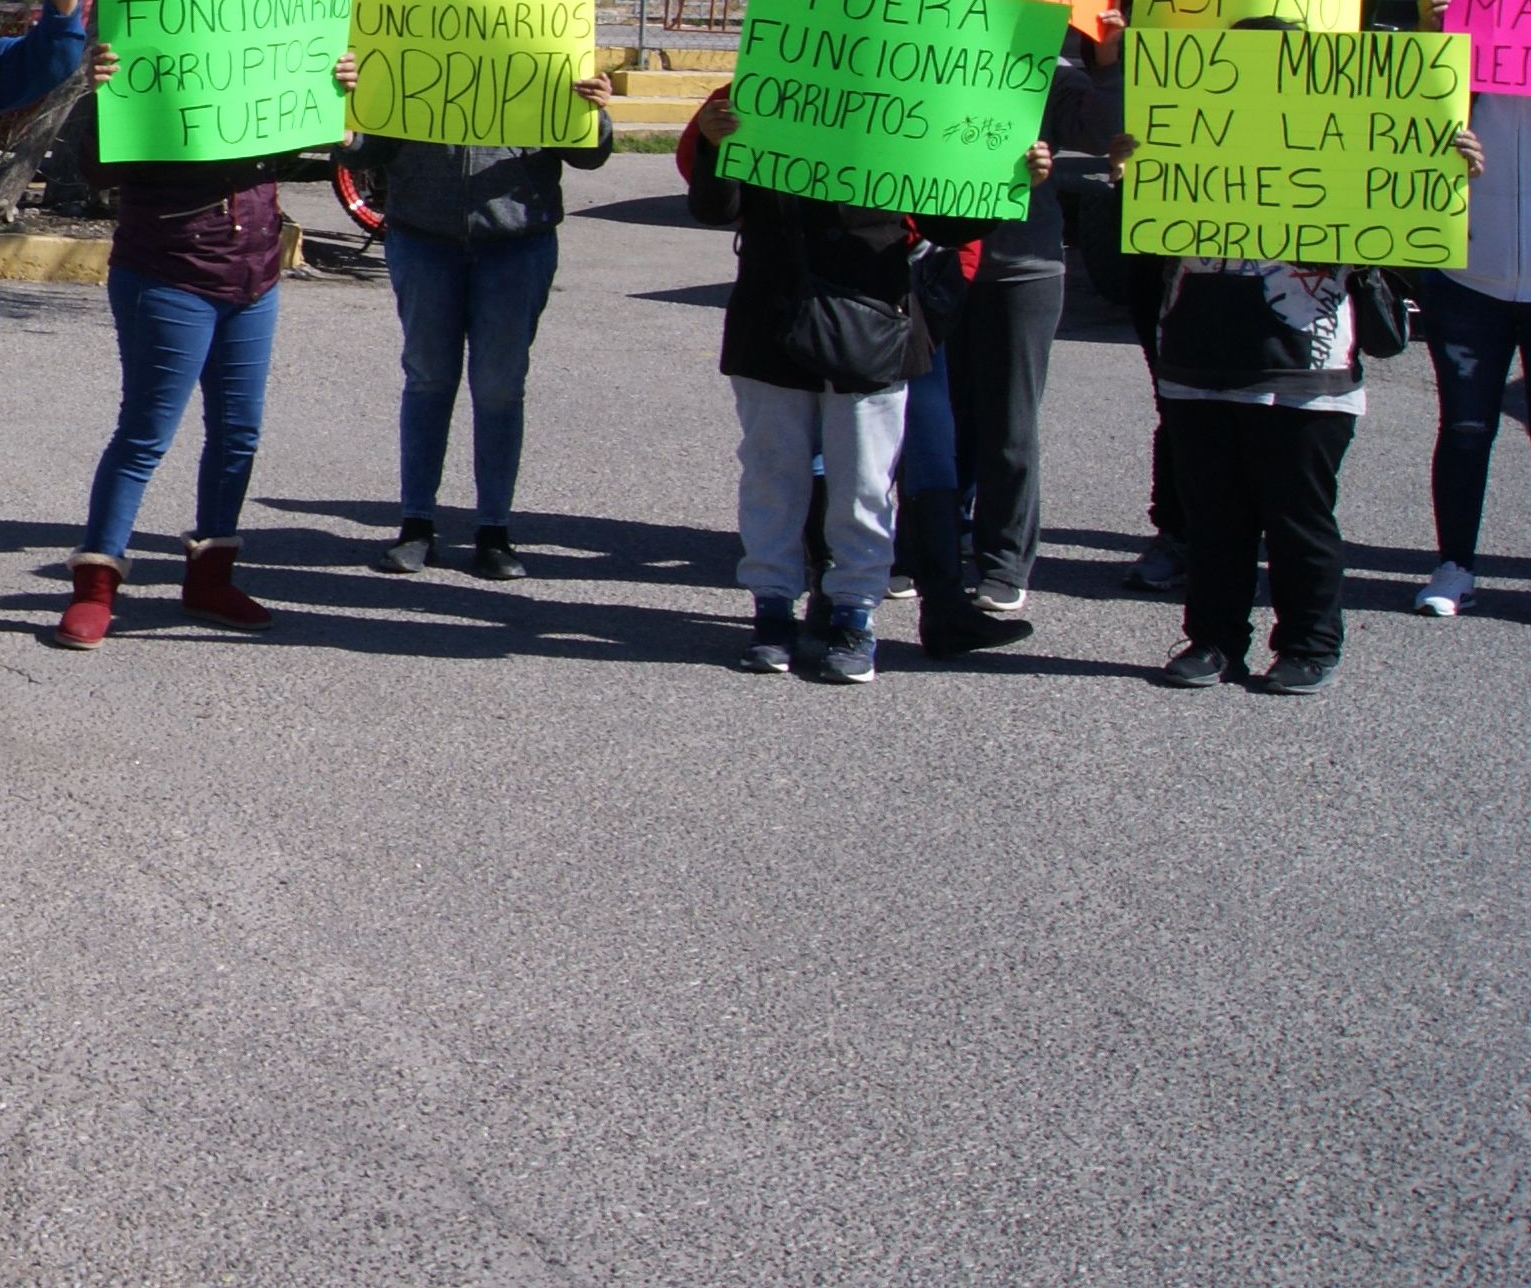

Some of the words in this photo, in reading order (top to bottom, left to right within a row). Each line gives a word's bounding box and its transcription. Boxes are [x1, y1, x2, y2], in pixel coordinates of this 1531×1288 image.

[355, 1, 592, 41] UNCIONARIOS
[745, 17, 1056, 93] FUNCIONARIOS
[1134, 31, 1239, 94] NOS
[1277, 30, 1459, 101] MORIMOS
[179, 88, 322, 146] FUERA
[348, 45, 594, 144] ORRUPTOS
[733, 72, 929, 140] CORRUPTOS
[1146, 104, 1234, 148] EN
[1282, 112, 1346, 152] LA
[721, 142, 1029, 221] EXTORSIONADORES
[1133, 159, 1327, 209] PINCHES
[1366, 166, 1467, 217] PUTOS
[1129, 218, 1451, 265] CORRUPTOS
